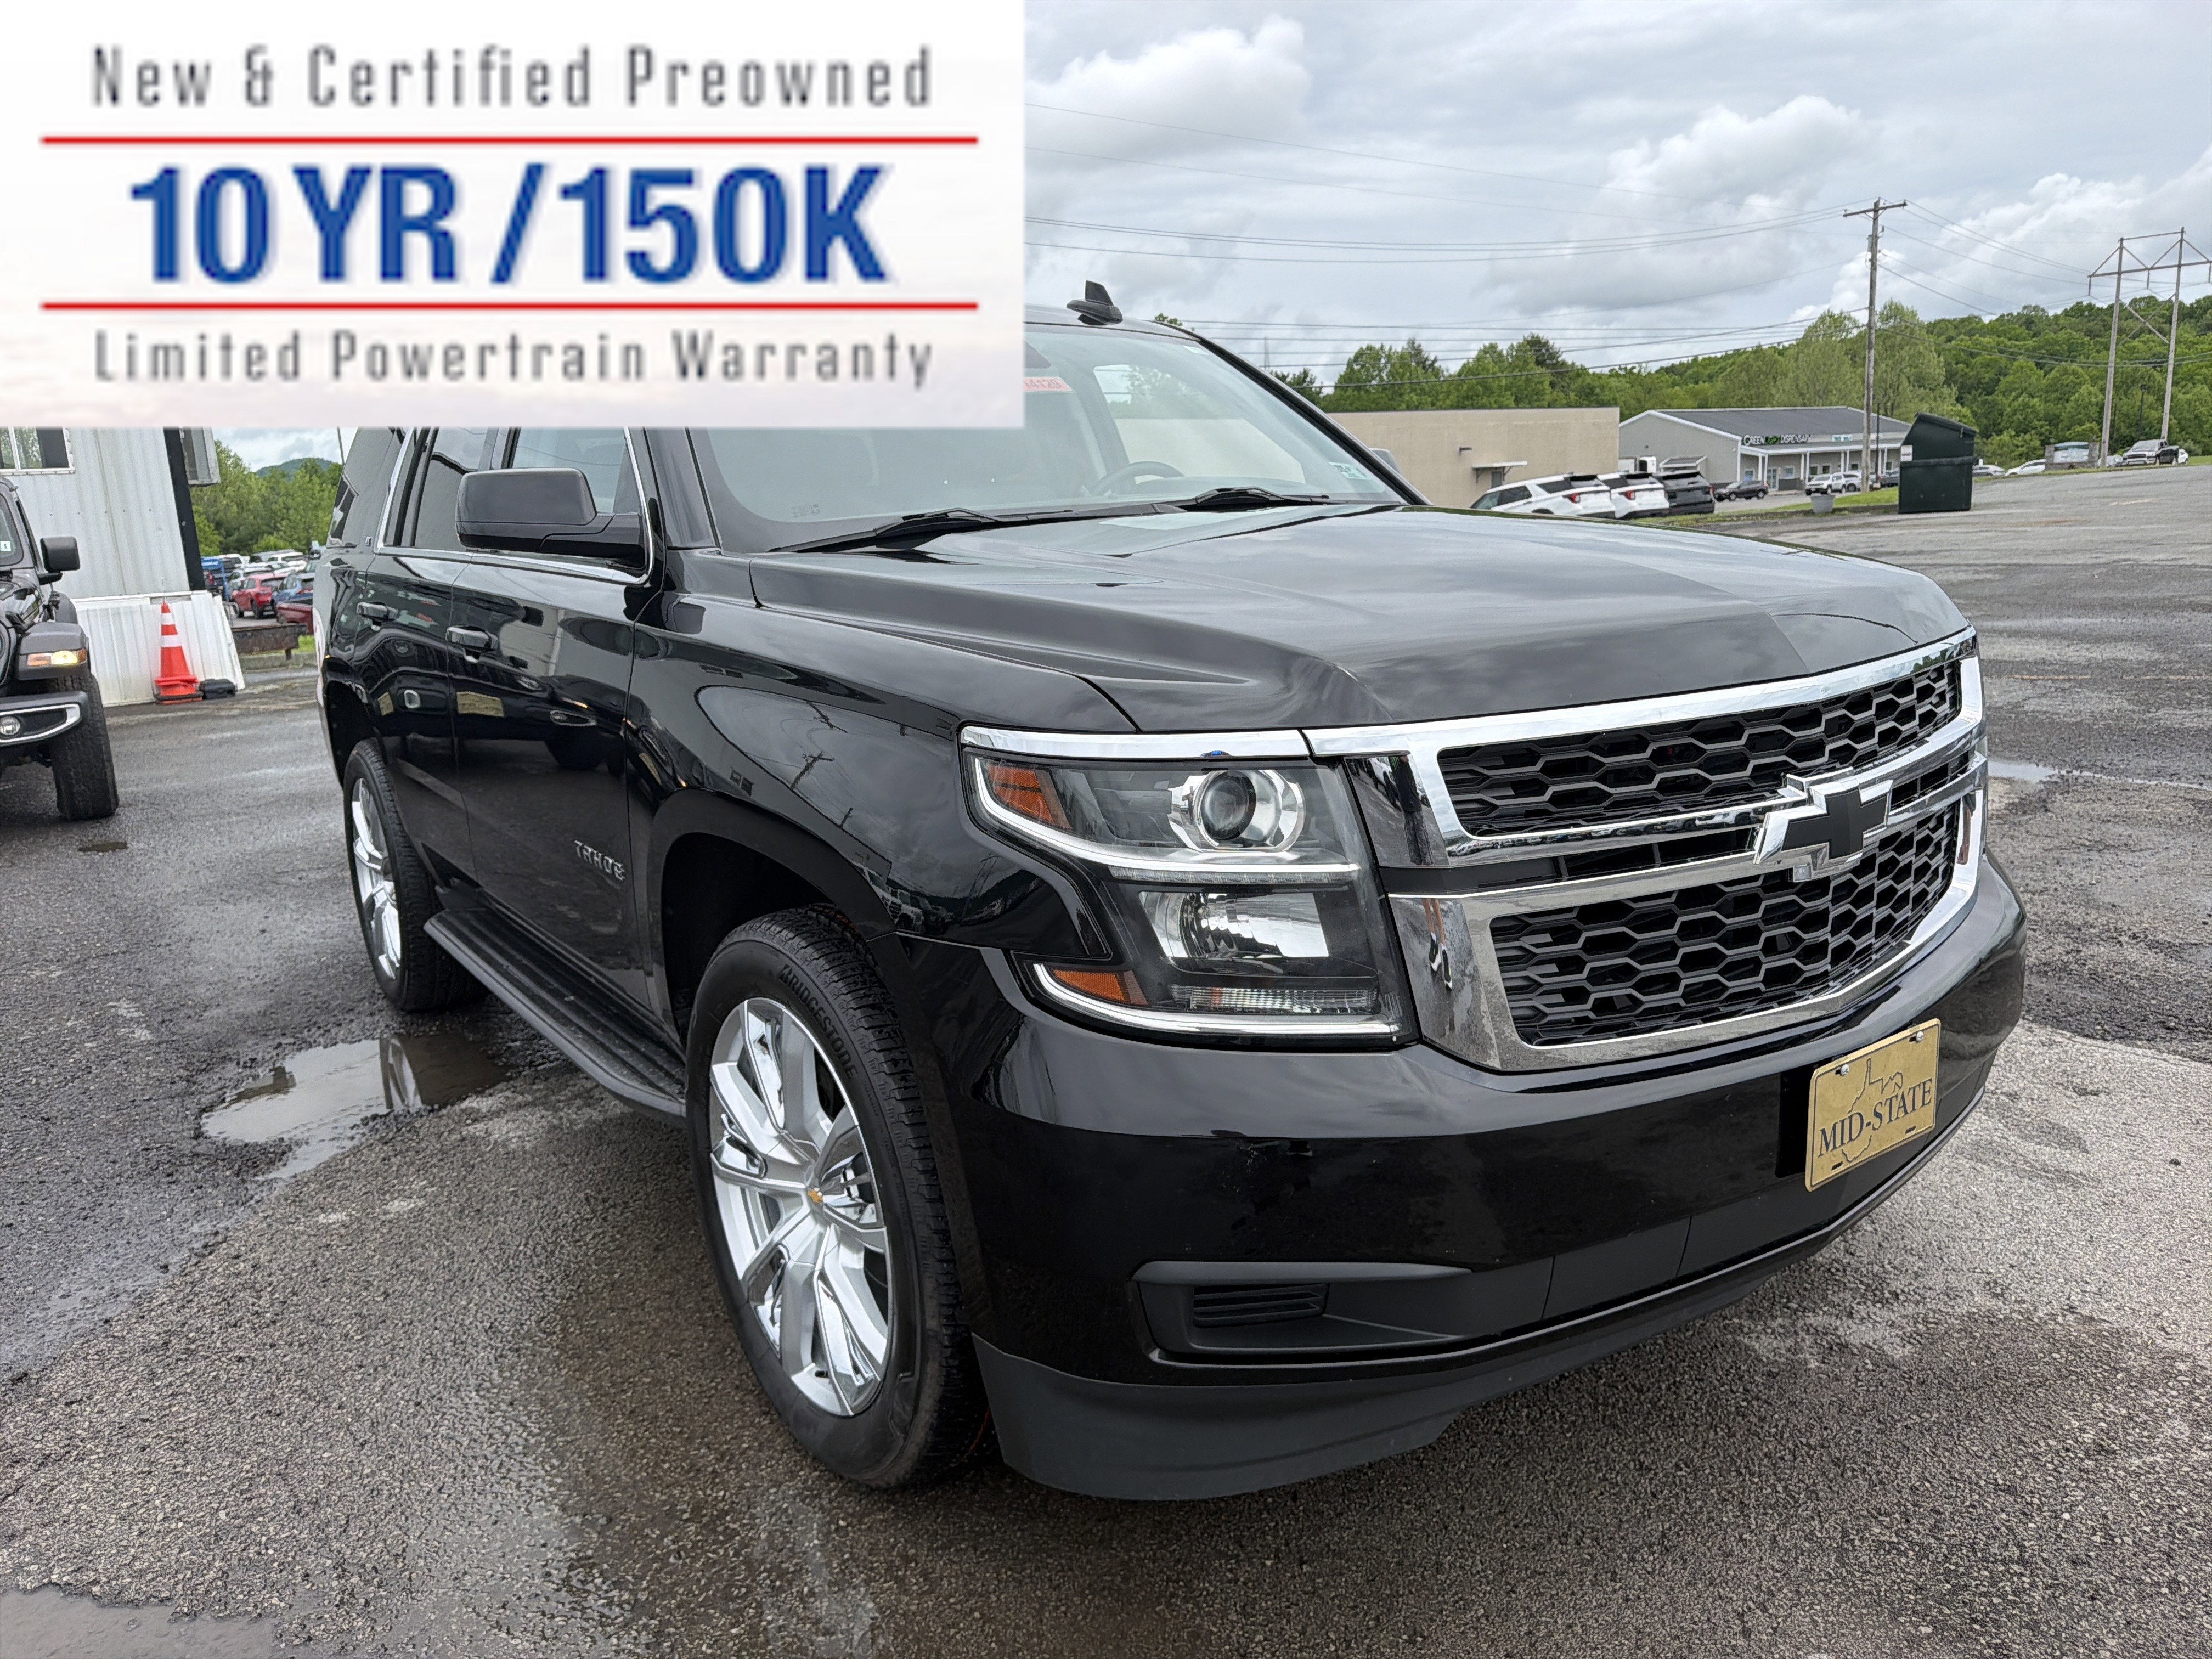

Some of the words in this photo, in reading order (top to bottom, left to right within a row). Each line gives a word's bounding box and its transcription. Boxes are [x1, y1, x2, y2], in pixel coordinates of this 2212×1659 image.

[574, 840, 625, 881] TAHOE
[778, 964, 858, 1079] BRIDGESTONE
[1817, 1078, 1933, 1158] MID-STATE
